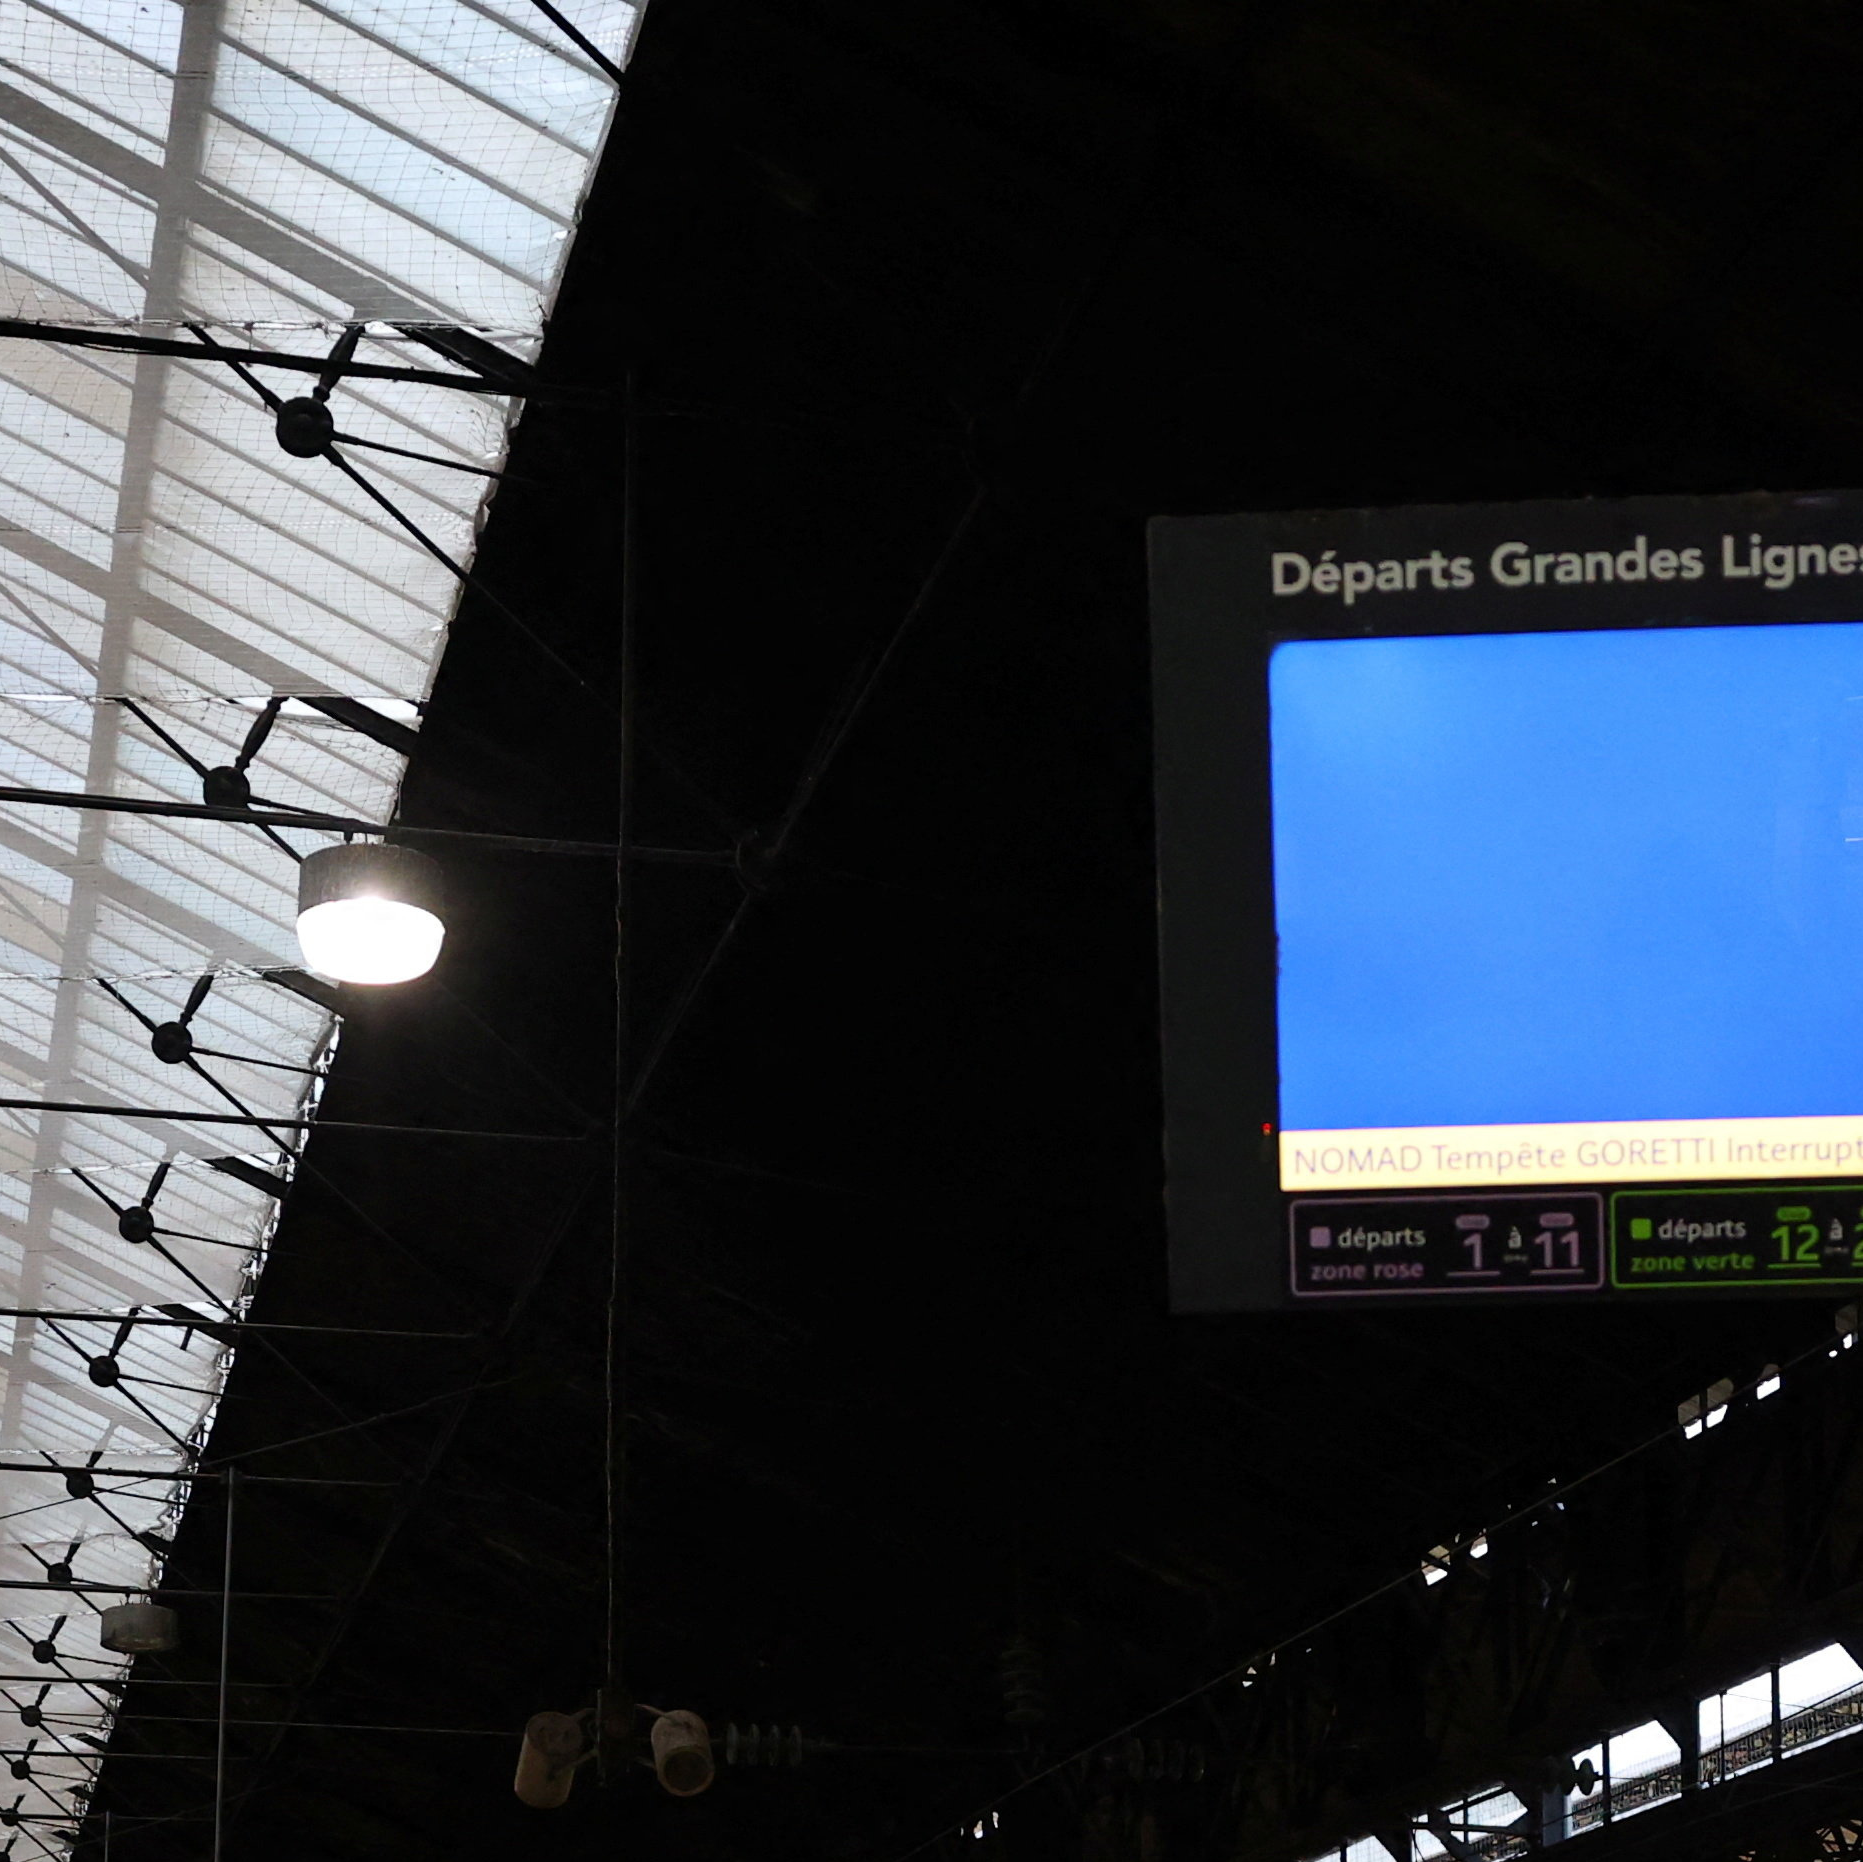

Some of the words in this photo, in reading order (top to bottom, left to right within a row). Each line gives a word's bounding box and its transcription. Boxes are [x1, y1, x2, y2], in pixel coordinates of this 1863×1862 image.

[1270, 548, 1475, 606] Départs
[1489, 535, 1705, 587] Grandes
[1294, 1144, 1422, 1175] NOMAD
[1431, 1141, 1566, 1175] Tempête
[1576, 1136, 1715, 1168] GORETTI
[1337, 1225, 1427, 1252] départs
[1657, 1217, 1748, 1244] départs
[1770, 1223, 1822, 1263] 12
[1462, 1231, 1484, 1270] 1
[1533, 1229, 1581, 1269] 11
[1629, 1256, 1687, 1274] zone
[1692, 1251, 1757, 1272] verte
[1310, 1265, 1369, 1282] zone
[1372, 1261, 1425, 1280] rose
